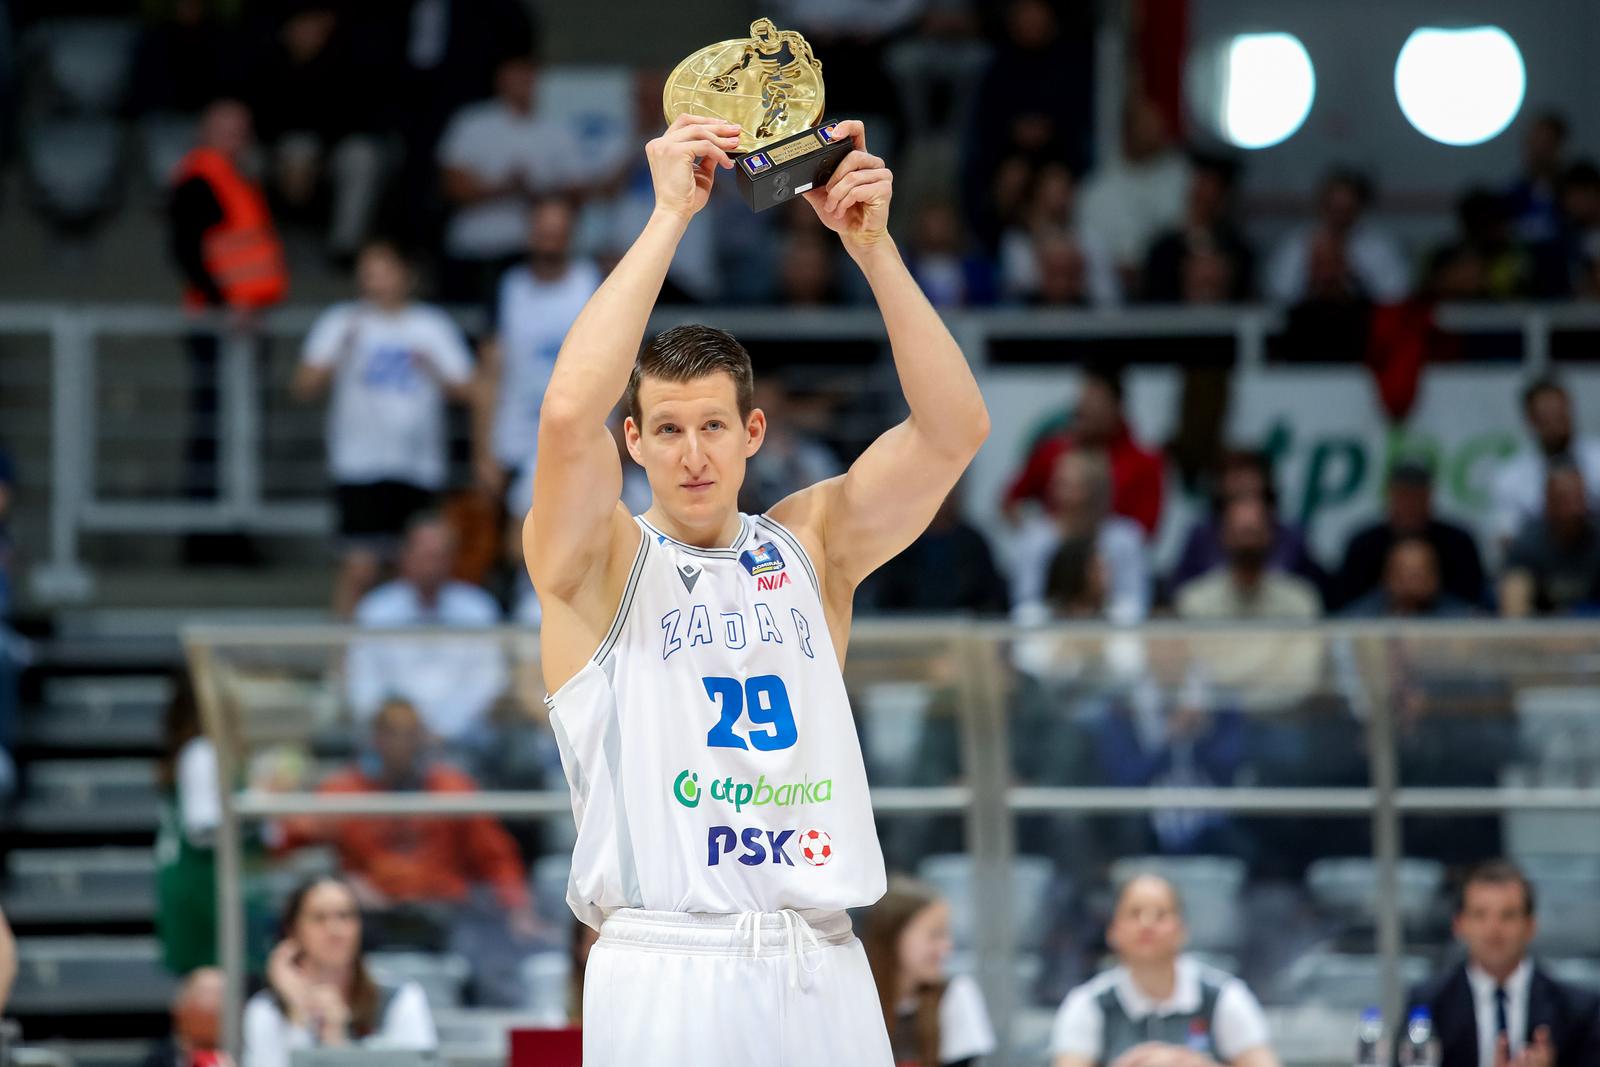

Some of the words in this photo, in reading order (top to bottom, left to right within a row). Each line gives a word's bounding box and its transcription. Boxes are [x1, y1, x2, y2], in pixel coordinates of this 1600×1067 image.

[752, 560, 783, 572] ADMIRAL
[757, 571, 791, 592] AVIA
[661, 603, 815, 661] ZADAR
[701, 674, 798, 752] 29
[707, 825, 796, 867] PSK
